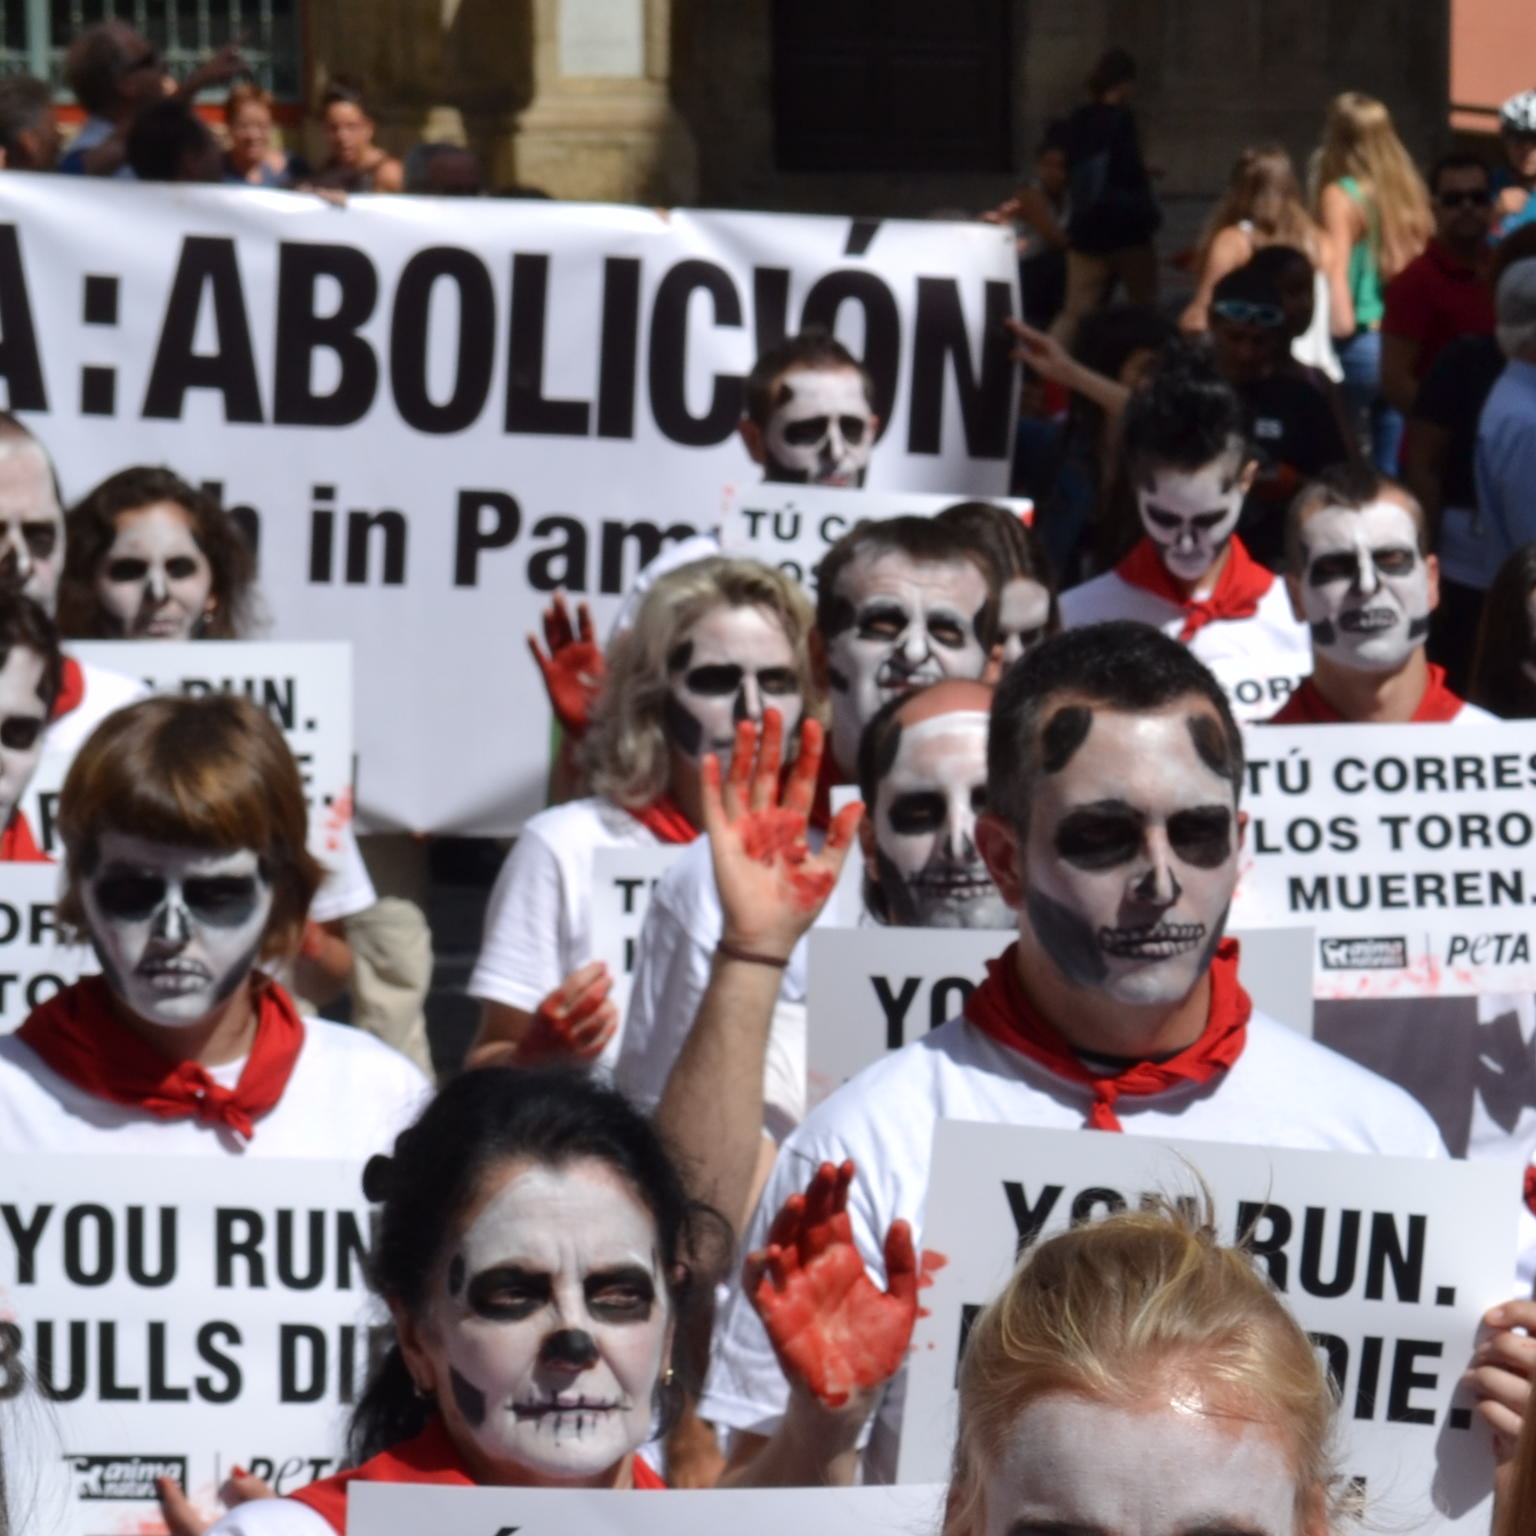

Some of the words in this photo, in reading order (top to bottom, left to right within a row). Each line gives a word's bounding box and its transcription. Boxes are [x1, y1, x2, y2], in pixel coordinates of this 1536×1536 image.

[308, 485, 403, 585] in
[453, 488, 719, 595] Pam
[741, 502, 802, 541] TÚ
[1245, 747, 1310, 795] TÚ
[1255, 816, 1360, 855] LOS
[1, 1203, 178, 1288] YOU
[1234, 1199, 1457, 1307] RUN.
